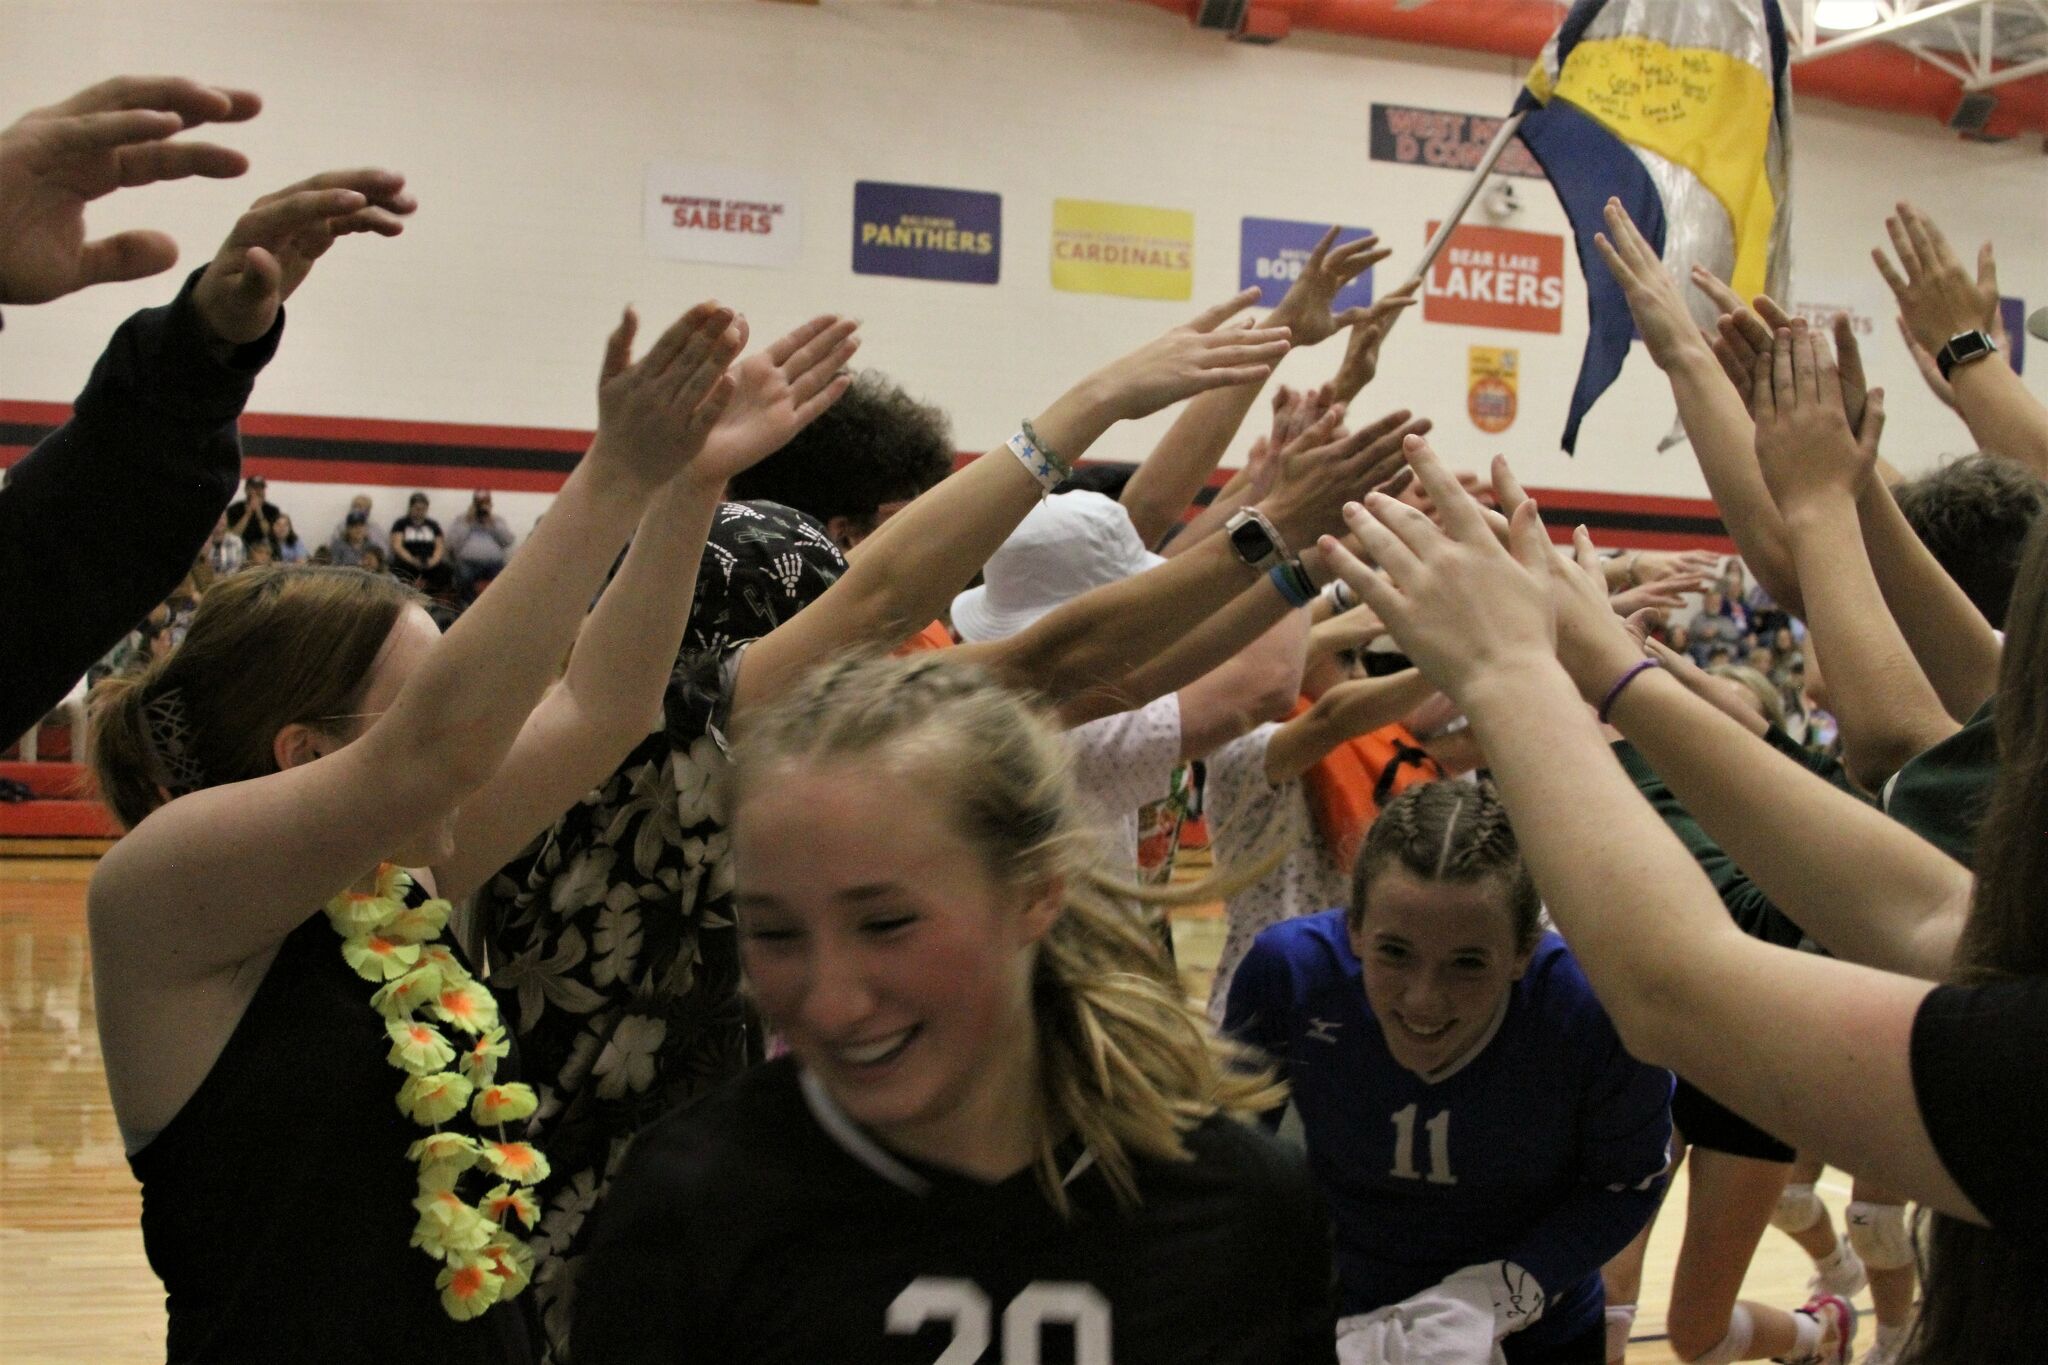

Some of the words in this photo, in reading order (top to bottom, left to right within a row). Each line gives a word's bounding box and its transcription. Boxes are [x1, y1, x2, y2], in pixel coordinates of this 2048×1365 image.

[673, 207, 771, 234] SABERS
[862, 222, 992, 255] PANTHERS
[1055, 240, 1191, 270] CARDINALS
[1448, 248, 1494, 266] BEAR
[1499, 253, 1538, 272] LAKE
[1425, 264, 1563, 309] LAKERS
[1389, 1103, 1458, 1185] 11
